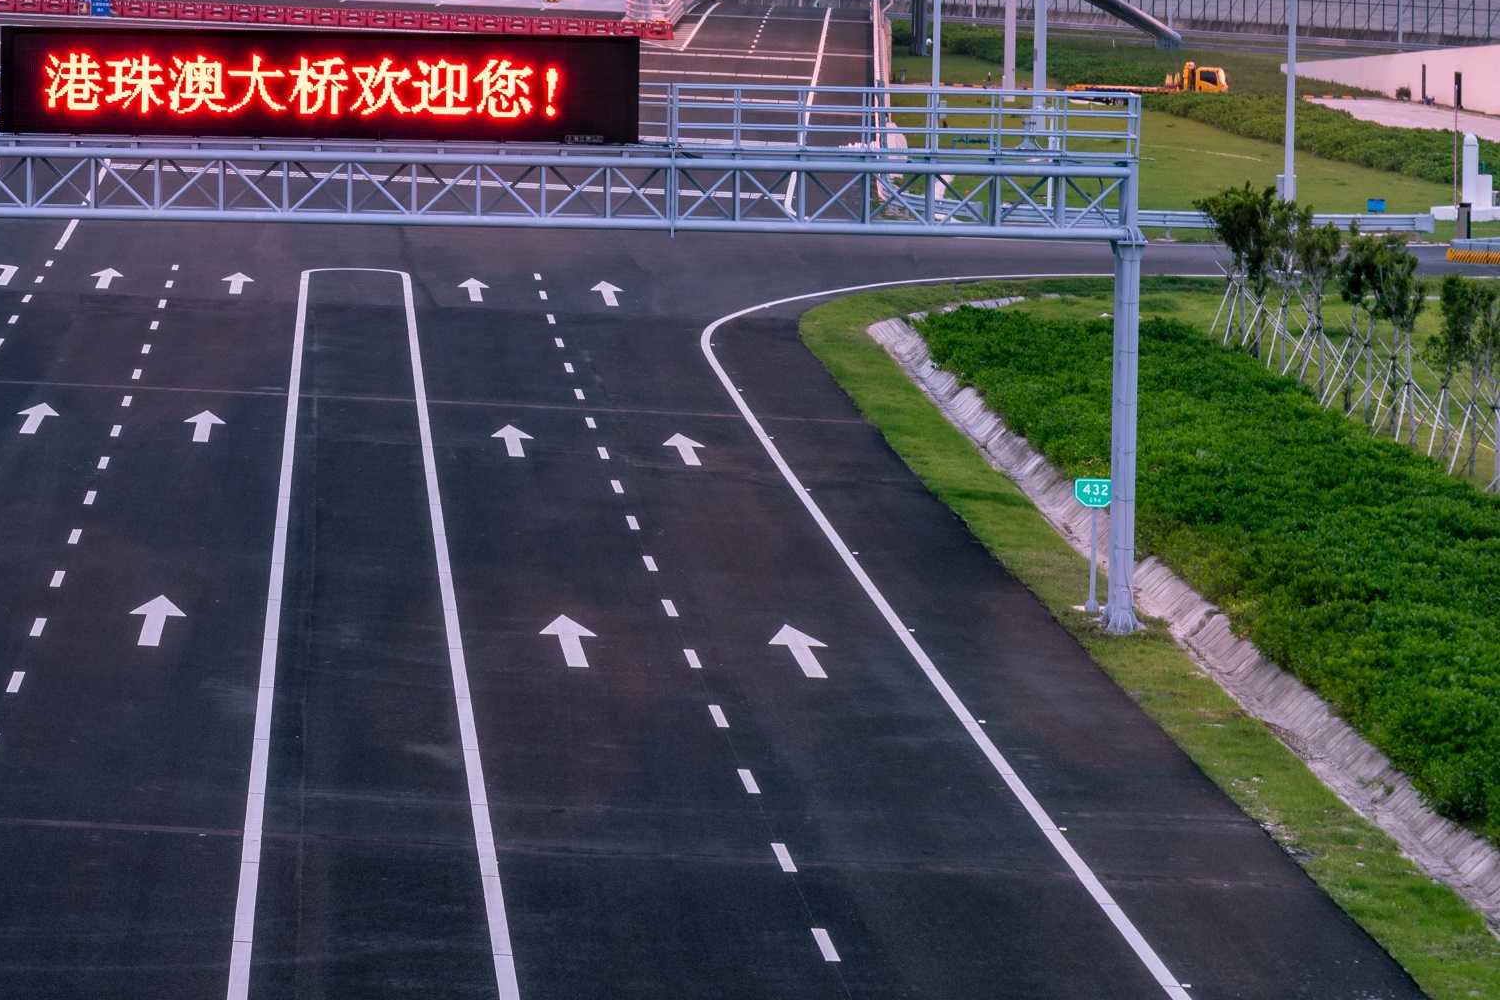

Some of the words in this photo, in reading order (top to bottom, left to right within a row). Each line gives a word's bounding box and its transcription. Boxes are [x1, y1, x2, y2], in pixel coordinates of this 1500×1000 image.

[45, 53, 559, 118] 港珠澳大桥欢迎您!
[1083, 484, 1108, 496] 432
